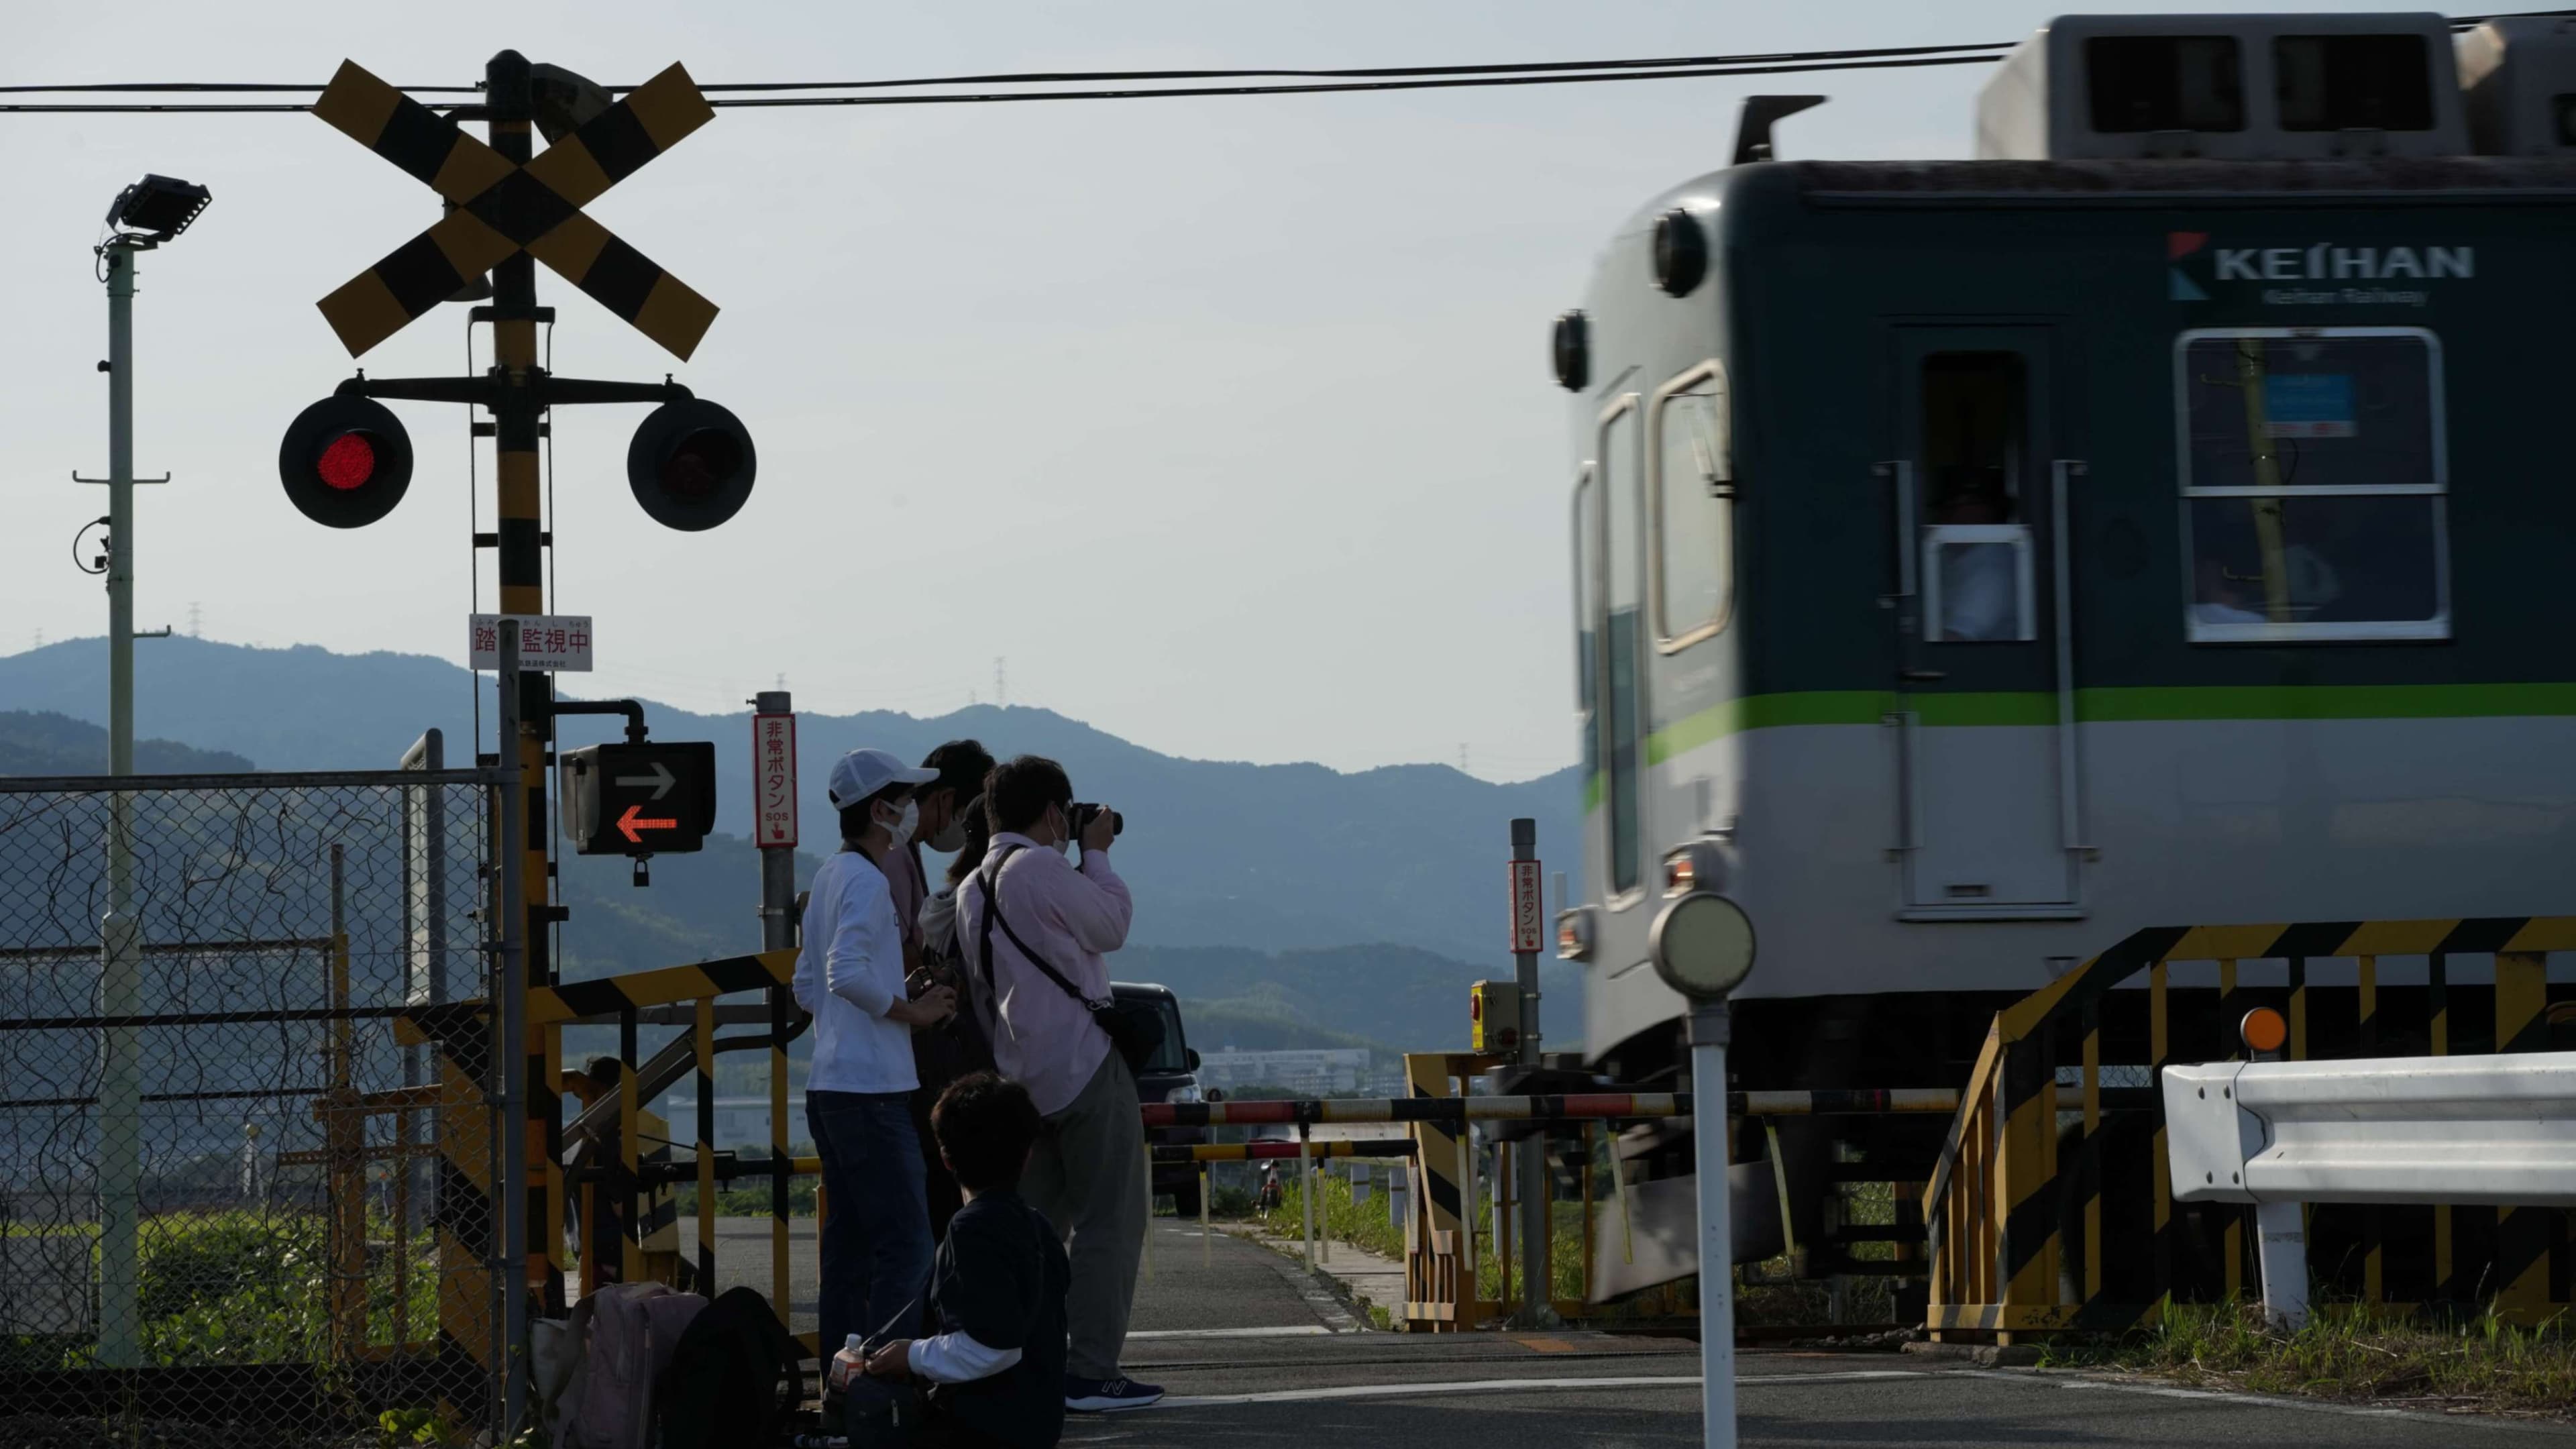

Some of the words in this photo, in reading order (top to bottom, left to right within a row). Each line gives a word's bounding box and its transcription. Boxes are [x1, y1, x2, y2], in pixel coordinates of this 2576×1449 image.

[475, 627, 588, 654] 踏監視中
[766, 720, 784, 808] 非常ボタン
[765, 812, 788, 821] SOS
[1521, 865, 1534, 925] 非常ボタン
